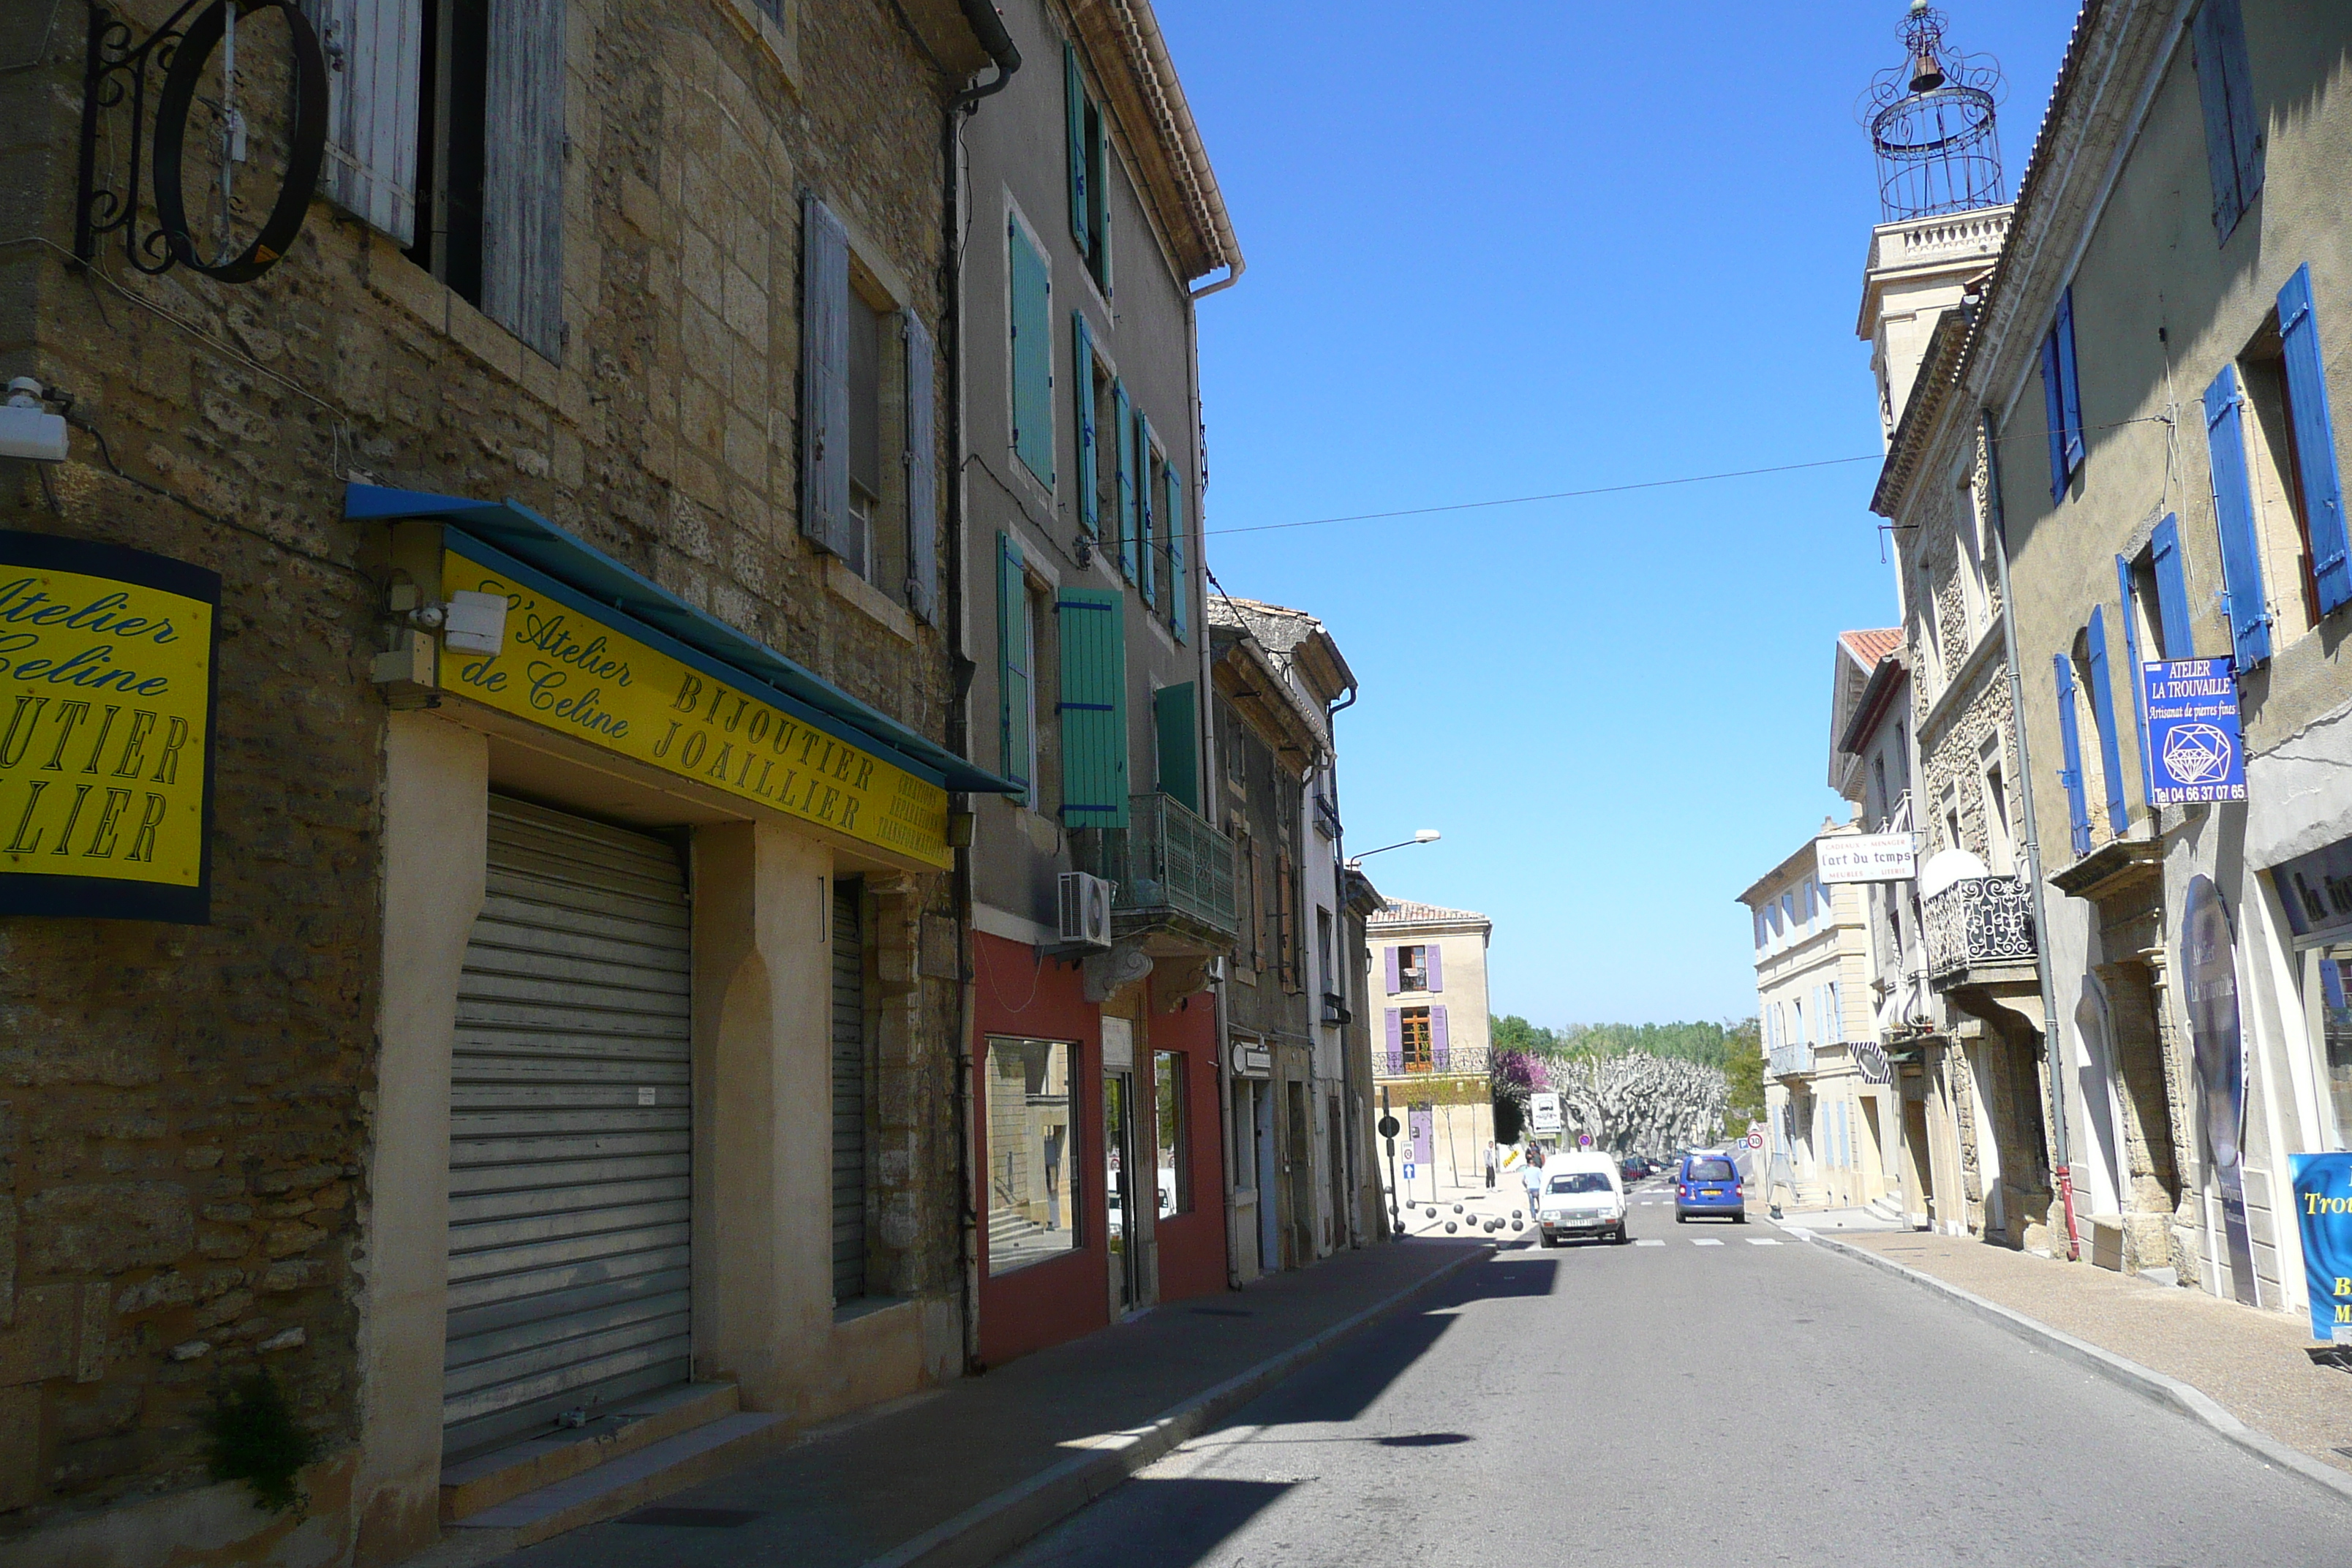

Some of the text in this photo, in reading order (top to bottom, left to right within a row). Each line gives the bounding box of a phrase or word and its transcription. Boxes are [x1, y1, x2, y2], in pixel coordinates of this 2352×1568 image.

[2169, 660, 2210, 679] ATELIER
[461, 657, 629, 739] de Celine
[2152, 677, 2231, 699] LA TROUVAILLE
[2149, 700, 2236, 722] Artisanat de pierres fines
[669, 672, 873, 791] BIJOUTIER
[652, 720, 859, 830] JOAILLIER
[2155, 784, 2244, 802] Tel 04 66 37 07 65
[0, 779, 167, 862] LIER
[1825, 842, 1860, 851] CADEAUX
[1822, 852, 1911, 867] l'art du temps
[1829, 870, 1863, 878] MEUBLES
